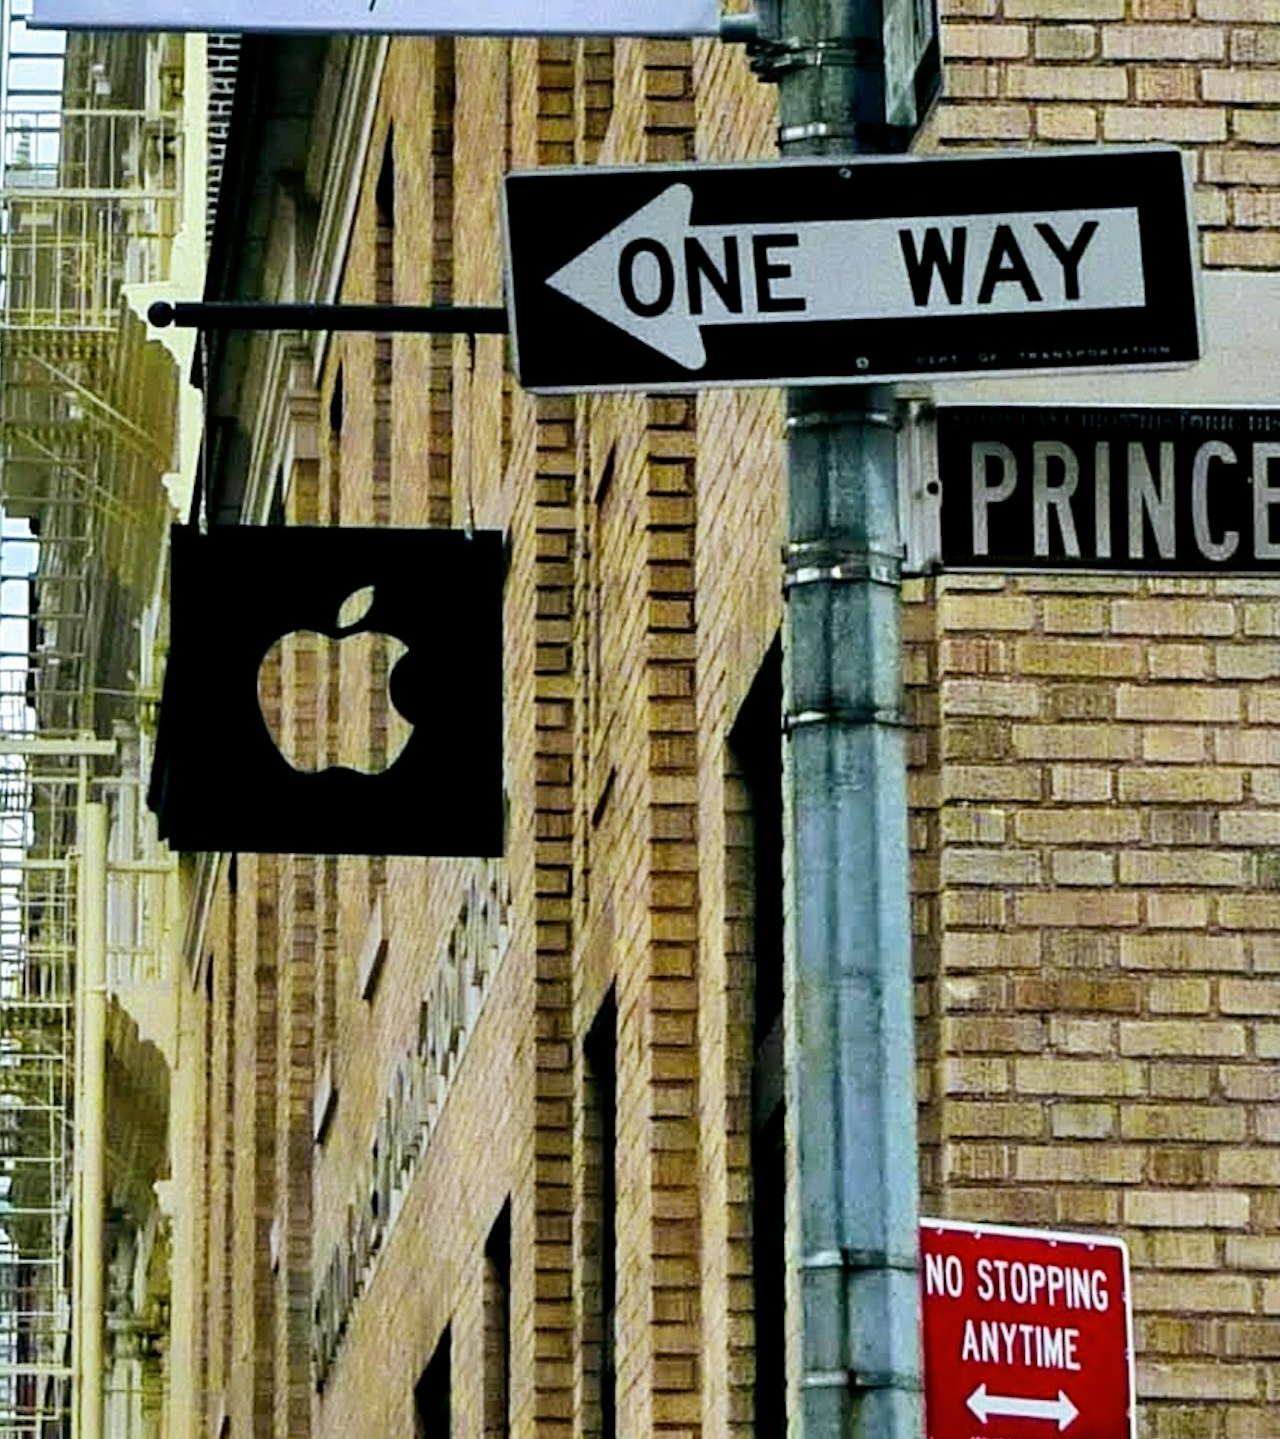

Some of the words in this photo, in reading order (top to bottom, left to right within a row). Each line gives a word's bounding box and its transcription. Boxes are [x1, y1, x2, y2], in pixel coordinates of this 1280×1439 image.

[617, 233, 806, 319] ONE
[898, 220, 1099, 306] WAY
[971, 440, 1280, 562] PRINCE
[925, 1253, 962, 1298] NO
[977, 1258, 1108, 1311] STOPPING
[962, 1319, 1081, 1370] ANYTIME
